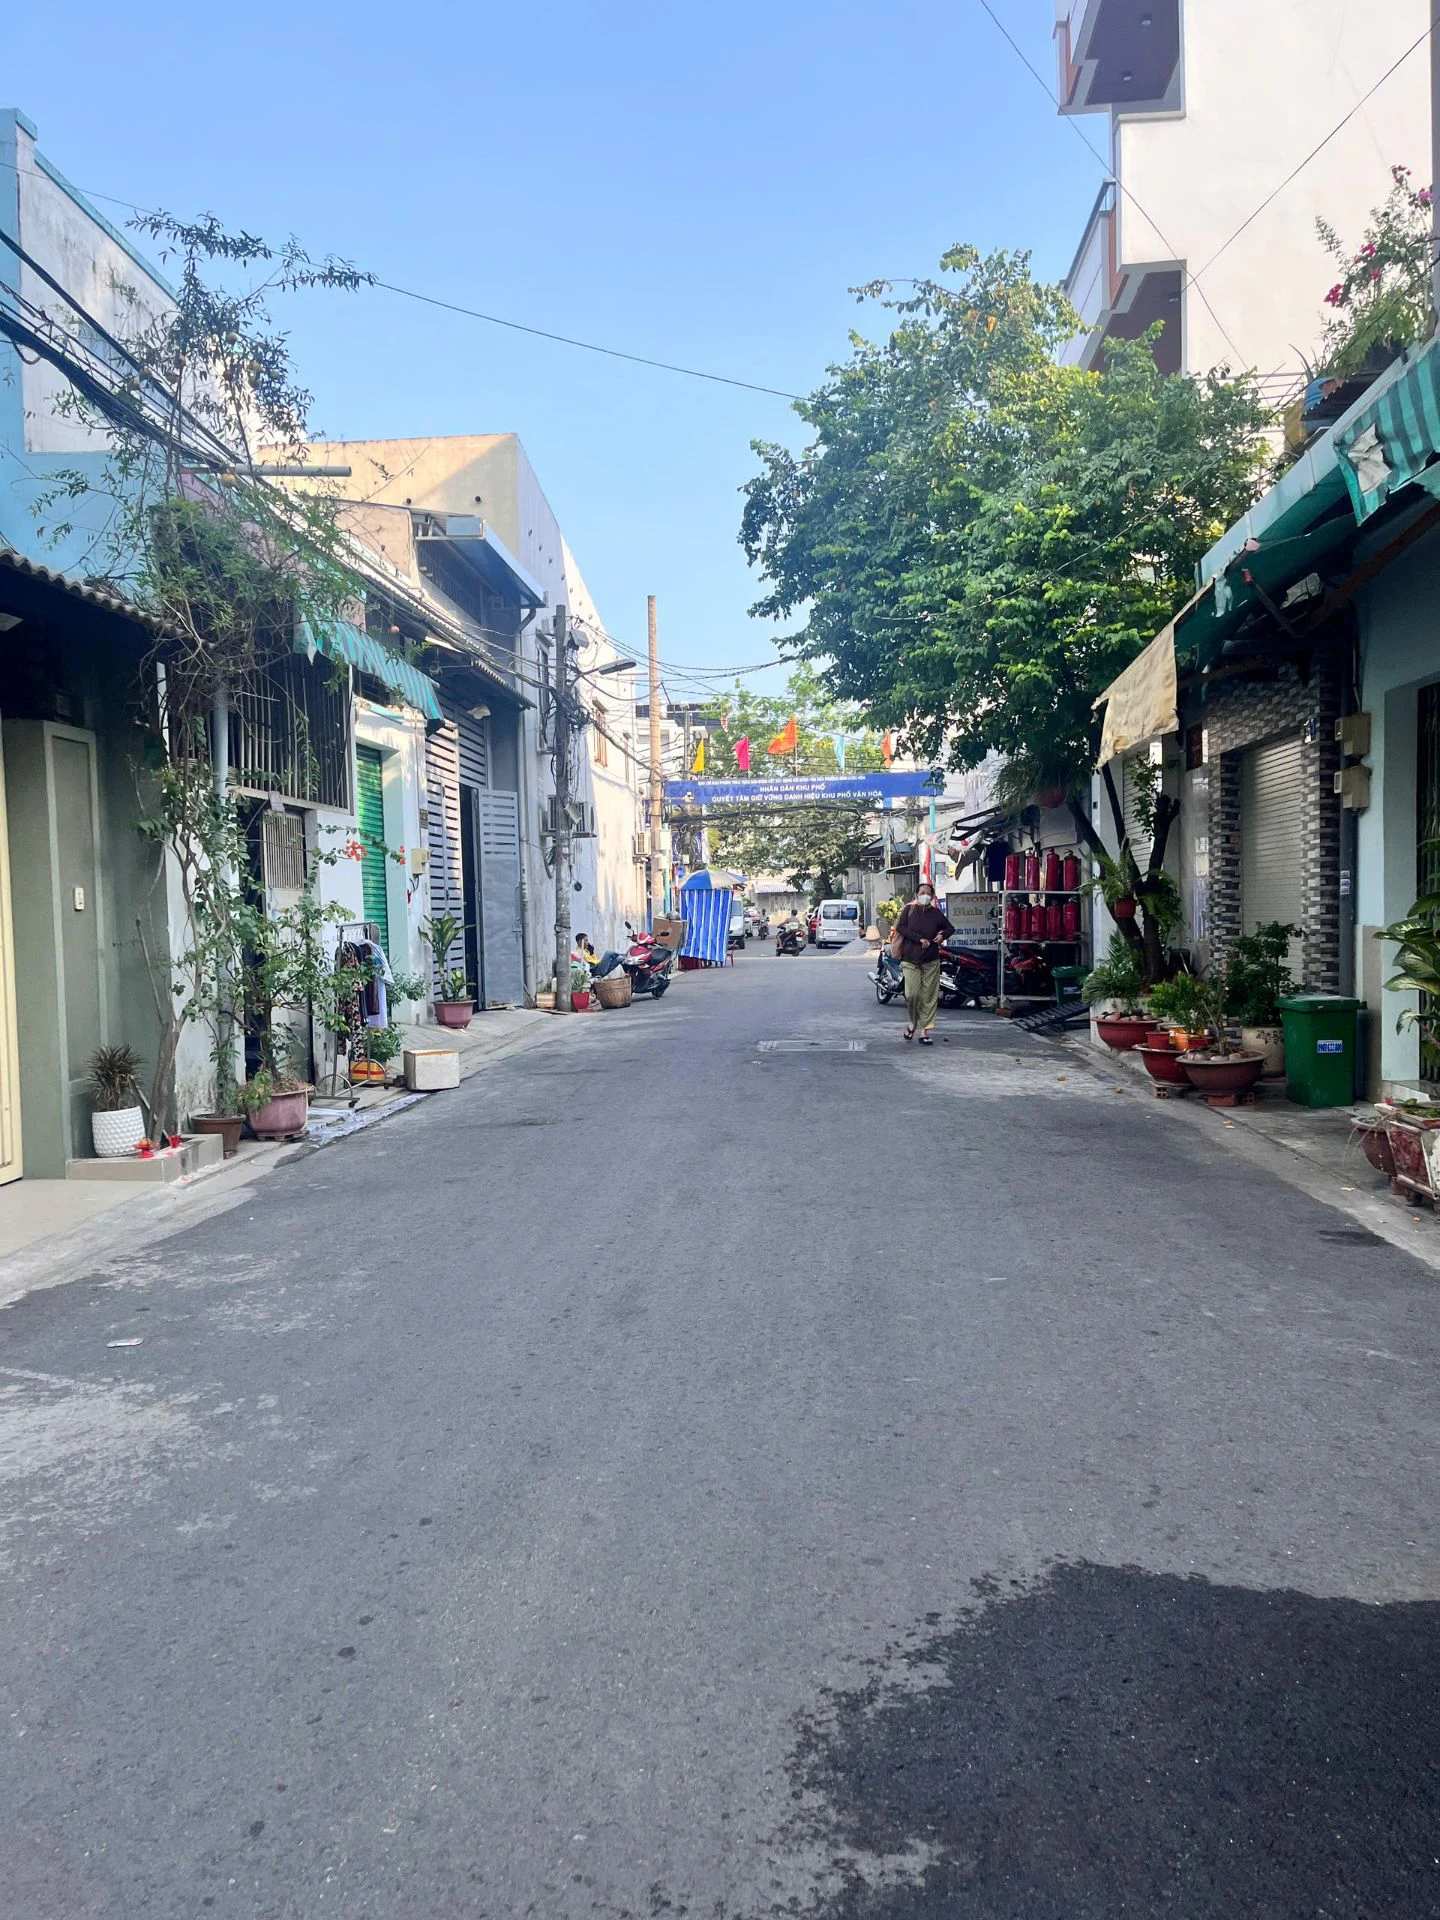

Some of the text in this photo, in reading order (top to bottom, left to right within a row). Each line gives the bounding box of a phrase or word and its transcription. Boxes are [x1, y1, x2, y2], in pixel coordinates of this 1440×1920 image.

[811, 782, 826, 790] PHỐ
[821, 791, 835, 799] KHU
[837, 790, 851, 798] PHỐ
